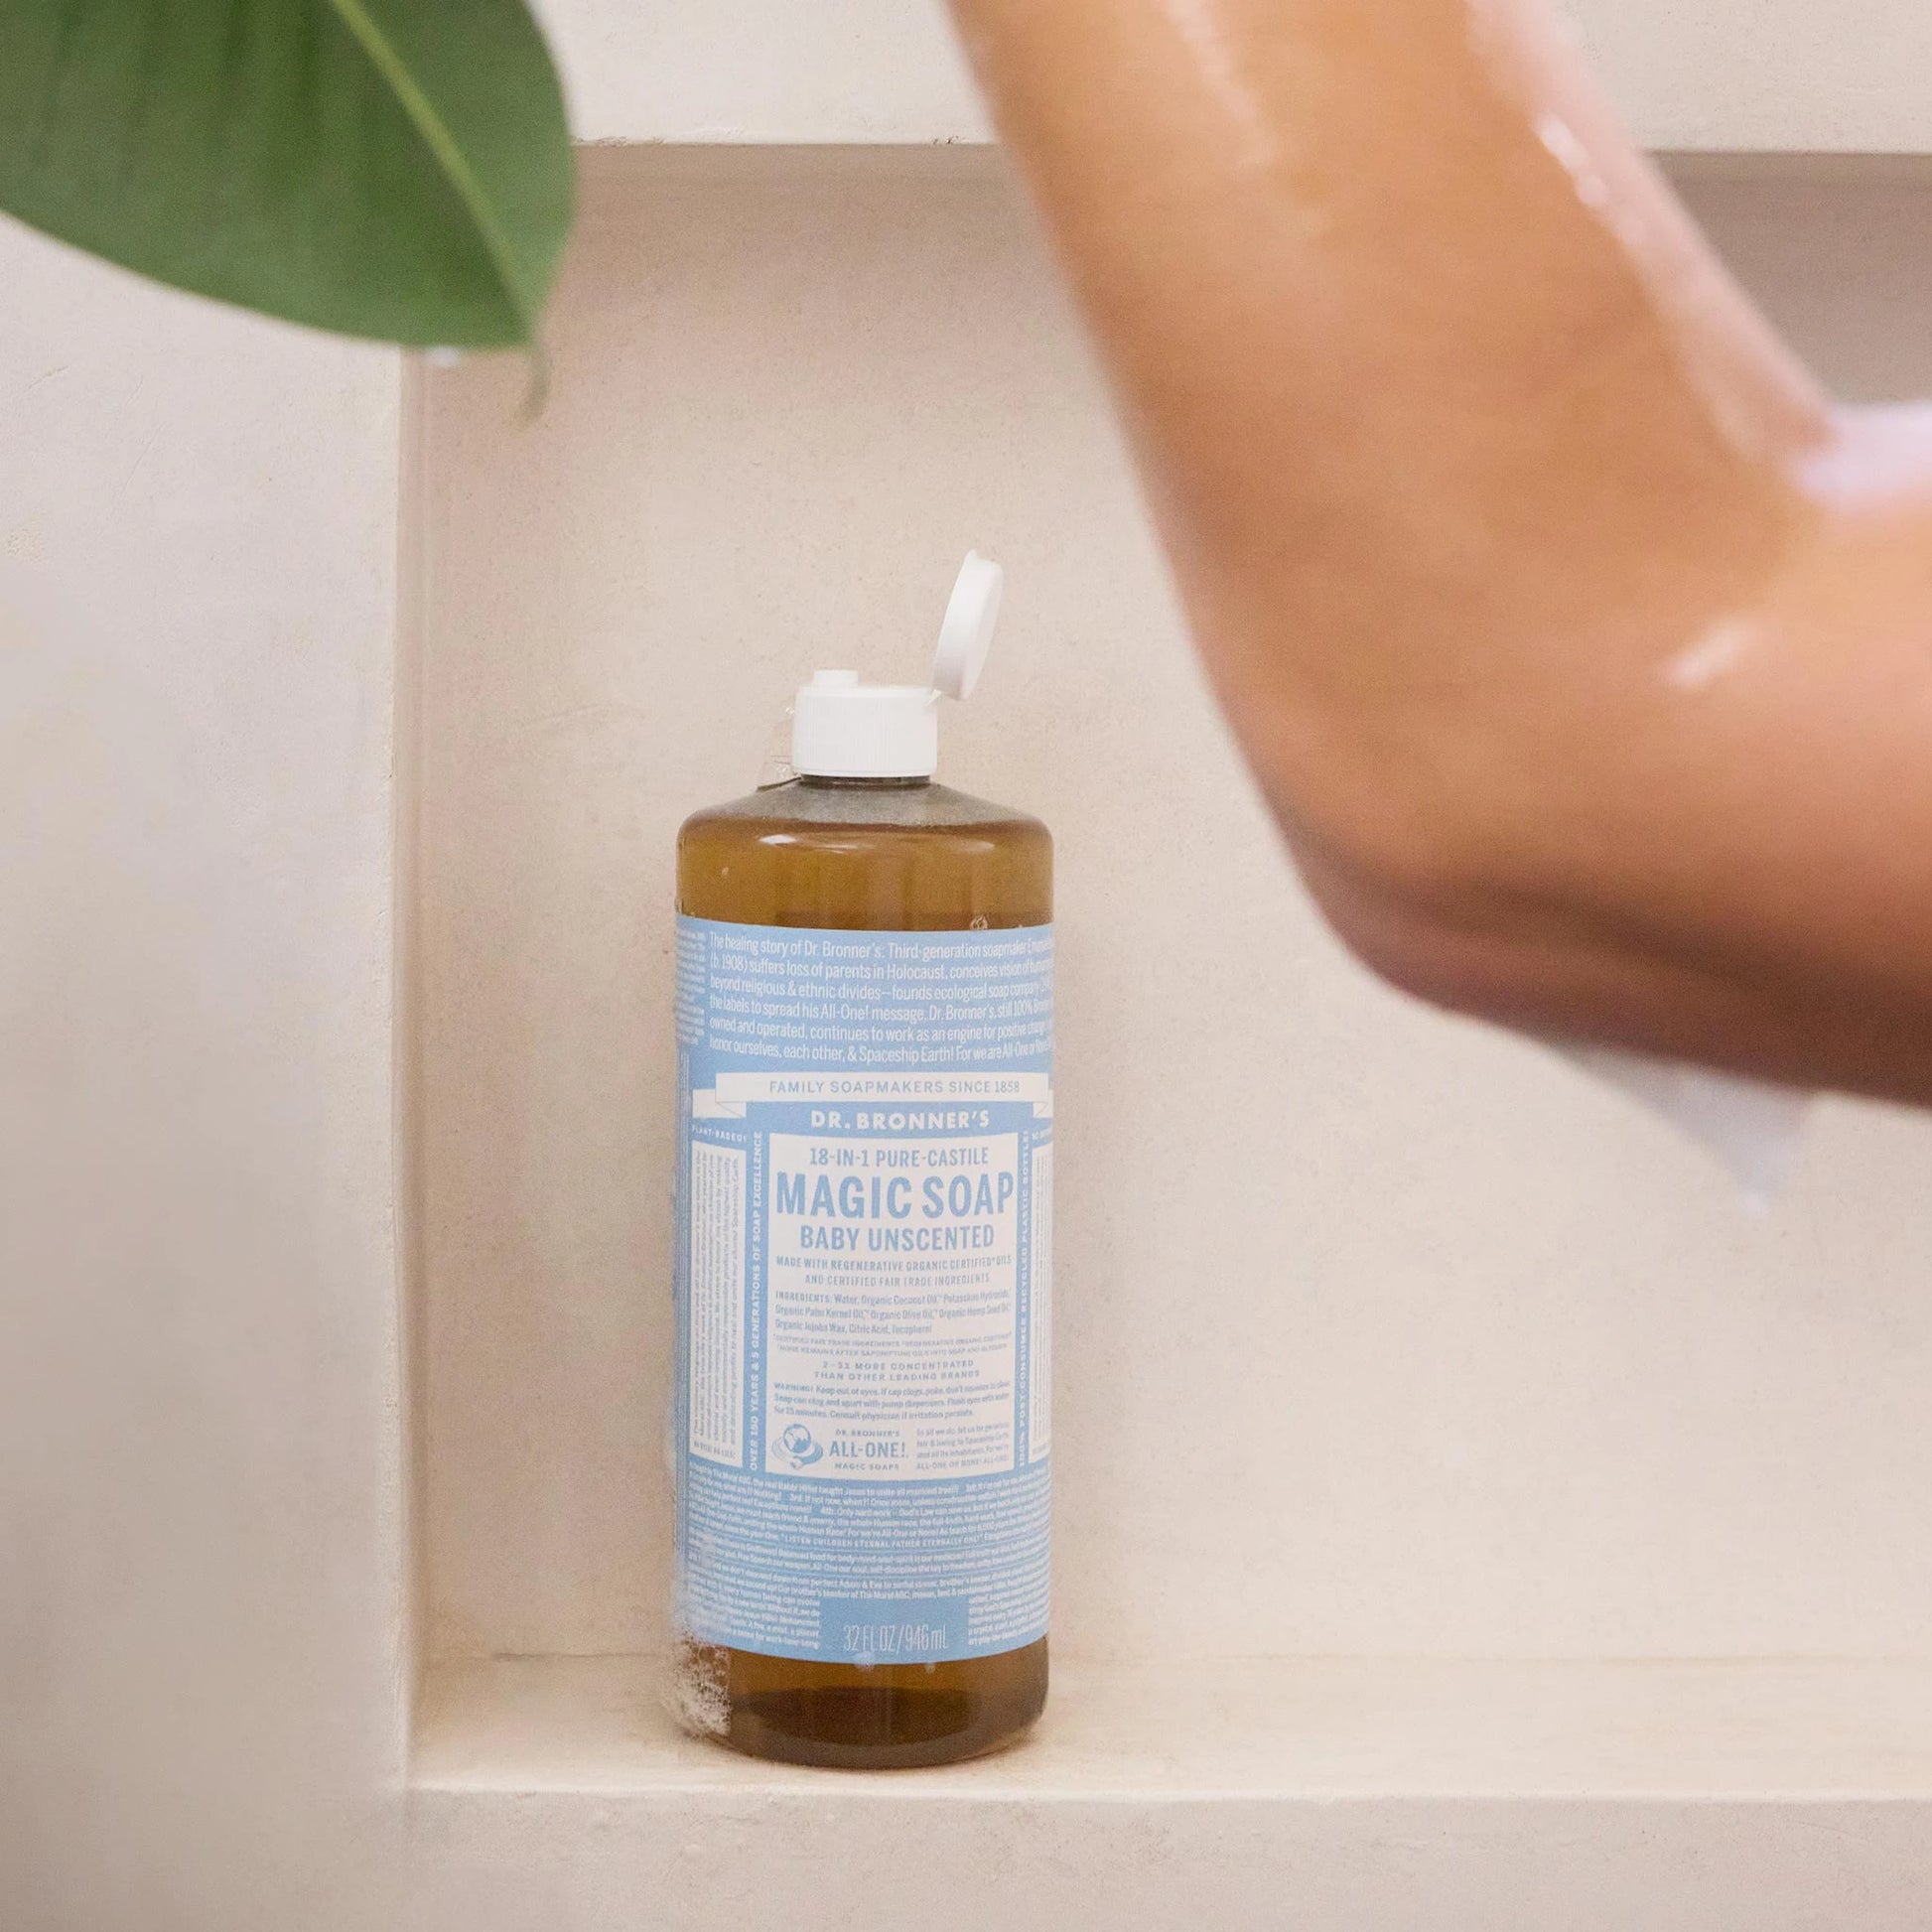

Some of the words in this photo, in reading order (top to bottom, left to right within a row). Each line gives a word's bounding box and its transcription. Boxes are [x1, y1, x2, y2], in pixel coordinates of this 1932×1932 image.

[710, 931, 723, 949] The
[726, 934, 759, 955] healing
[760, 938, 787, 957] story
[790, 940, 803, 954] of
[805, 942, 817, 956] Dr.
[889, 943, 981, 962] Third-generation
[722, 953, 747, 972] 1908)
[750, 958, 784, 975] suffers
[787, 961, 808, 976] loss
[811, 962, 823, 976] of
[825, 963, 871, 980] parents
[874, 965, 884, 979] in
[887, 964, 947, 980] Holocaust,
[950, 963, 998, 979] conceives
[710, 974, 742, 994] beyond
[743, 977, 785, 997] religious
[786, 981, 796, 995] &
[798, 981, 836, 999] ethnic
[936, 984, 986, 1003] ecological
[988, 984, 1008, 999] soap
[724, 996, 750, 1013] labels
[752, 999, 761, 1015] to
[762, 1002, 799, 1019] spread
[803, 1003, 818, 1019] his
[821, 1004, 868, 1020] All-One!
[872, 1007, 926, 1024] message.
[929, 1006, 943, 1021] Dr.
[998, 1002, 1012, 1018] still
[710, 1017, 736, 1033] owned
[738, 1018, 756, 1033] and
[810, 1024, 867, 1041] continues
[872, 1028, 884, 1041] to
[886, 1028, 914, 1041] work
[916, 1030, 929, 1041] as
[932, 1030, 944, 1041] an
[947, 1028, 983, 1043] engine
[984, 1024, 997, 1039] for
[998, 1023, 1026, 1040] positive
[710, 1035, 732, 1050] honor
[783, 1043, 810, 1059] each
[847, 1046, 858, 1062] &
[859, 1046, 918, 1064] Spaceship
[921, 1046, 954, 1062] Earth!
[956, 1045, 971, 1061] For
[973, 1047, 985, 1059] we
[986, 1047, 1002, 1059] are
[770, 1080, 824, 1093] FAMILY
[830, 1080, 943, 1093] SOAPMAKERS
[949, 1080, 991, 1093] SINCE
[995, 1080, 1020, 1093] 1858
[811, 1110, 851, 1129] DR.
[857, 1110, 990, 1130] BRONNER’S
[810, 1148, 870, 1167] 18-IN-1
[876, 1147, 989, 1167] PURE-CASTILE
[776, 1171, 911, 1219] MAGIC
[922, 1172, 1014, 1218] SOAP
[800, 1225, 860, 1251] BABY
[869, 1224, 994, 1252] UNSCENTED
[753, 1244, 760, 1260] OF
[776, 1255, 801, 1267] MADE
[804, 1259, 828, 1269] WITH
[831, 1260, 902, 1271] REGENERATIVE
[906, 1260, 948, 1271] ORGANIC
[805, 1275, 823, 1285] AND
[827, 1275, 876, 1287] CERTIFIED
[880, 1277, 900, 1287] FAIR
[903, 1277, 931, 1287] TRADE
[935, 1273, 990, 1286] INGREDIENTS
[752, 1265, 760, 1348] GENERATIONS
[861, 1295, 894, 1306] Organic
[894, 1295, 924, 1306] Coconut
[775, 1305, 803, 1316] Organic
[805, 1307, 825, 1316] Palm
[826, 1310, 852, 1318] Kernel
[871, 1311, 901, 1320] Organic
[902, 1310, 921, 1319] Olive
[939, 1309, 967, 1320] Organic
[849, 1324, 870, 1334] Citric
[855, 1361, 886, 1370] MORE
[891, 1360, 973, 1370] CONCENTRATED
[814, 1371, 844, 1380] THAN
[849, 1372, 885, 1381] OTHER
[862, 1412, 899, 1421] physician
[908, 1410, 943, 1420] irritation
[829, 1441, 905, 1457] ALL-ONE!
[843, 1624, 859, 1651] 32
[863, 1624, 877, 1651] FL
